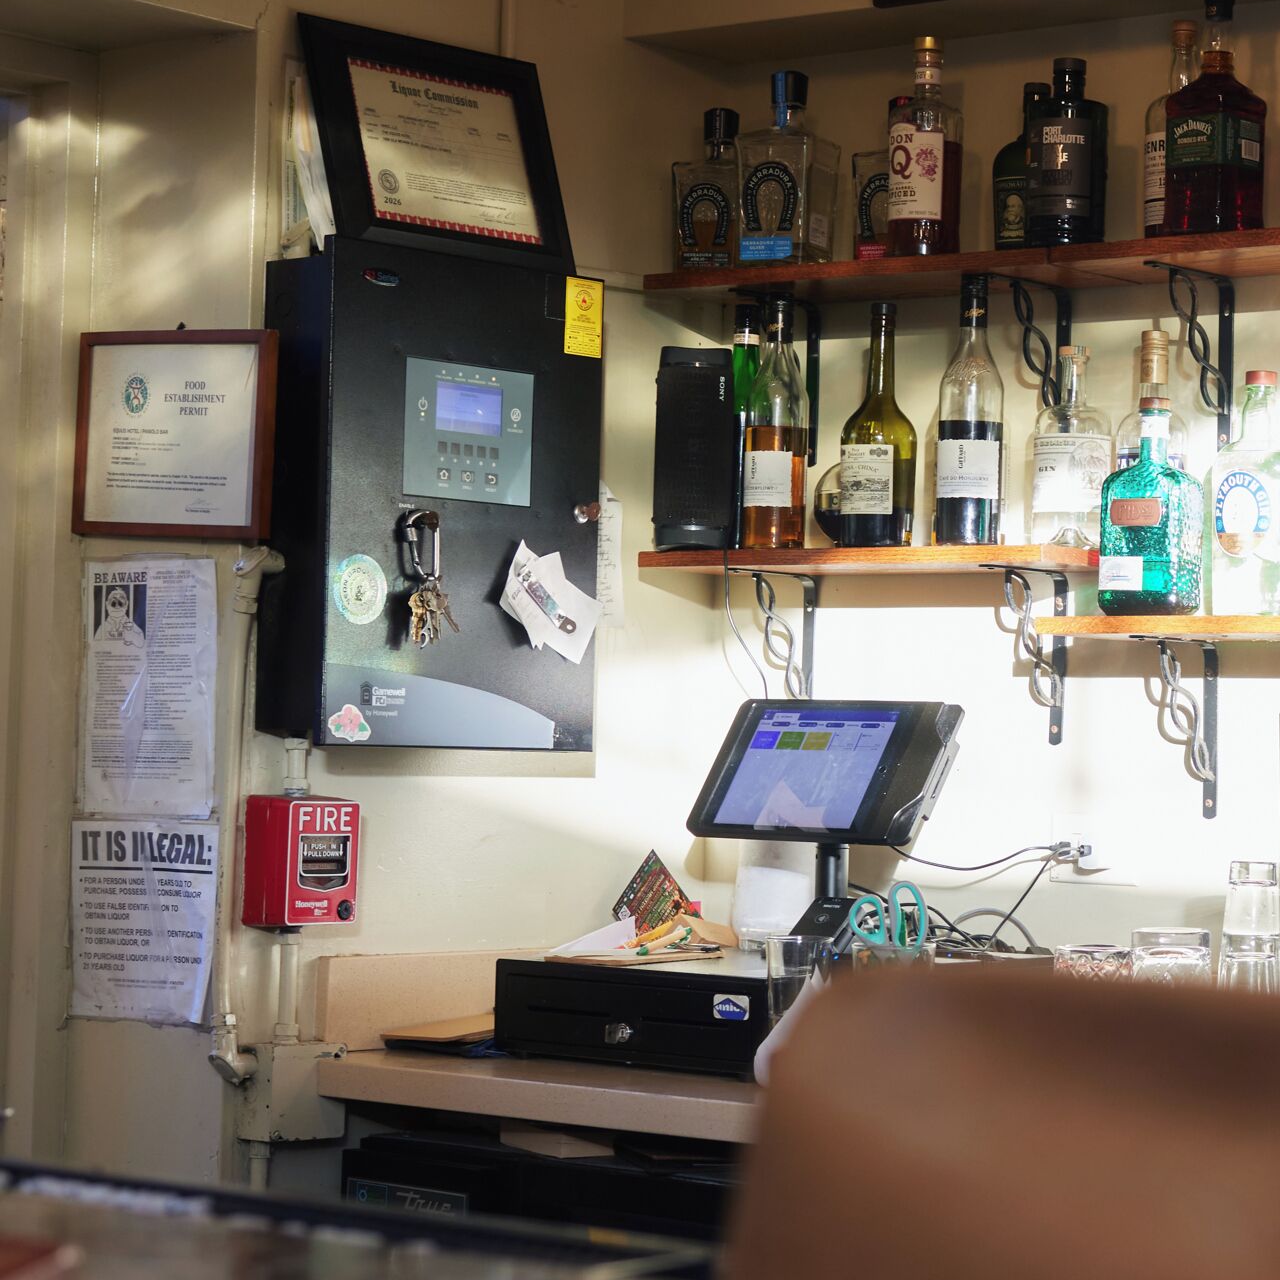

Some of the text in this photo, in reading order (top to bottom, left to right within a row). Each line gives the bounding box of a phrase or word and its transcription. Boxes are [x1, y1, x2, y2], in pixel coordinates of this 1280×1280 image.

[389, 80, 422, 97] Liquor
[424, 88, 480, 109] Commission
[1042, 126, 1063, 135] PORT
[1173, 122, 1189, 138] JACK
[890, 134, 914, 145] DON
[1042, 135, 1085, 144] CHARLOTTE
[891, 145, 913, 180] Q
[748, 168, 792, 188] HERRADURA
[384, 196, 402, 206] 2026
[684, 188, 727, 207] HERRADURA
[185, 381, 206, 390] FOOD
[164, 393, 227, 404] ESTABLISHMENT
[179, 407, 208, 416] PERMIT
[1038, 465, 1056, 473] GIN
[1216, 474, 1260, 516] PLYMOUTH
[94, 573, 109, 583] BE
[110, 572, 148, 583] AWARE
[372, 686, 406, 697] Gamewell
[299, 807, 352, 832] FIRE
[82, 831, 100, 861] IT
[106, 831, 126, 862] IS
[157, 879, 175, 887] YEARS
[295, 900, 328, 909] Honeywell
[108, 928, 134, 936] ANOTHER
[93, 953, 125, 961] PURCHASE
[126, 954, 149, 962] LIQUOR
[166, 956, 190, 964] PRSON
